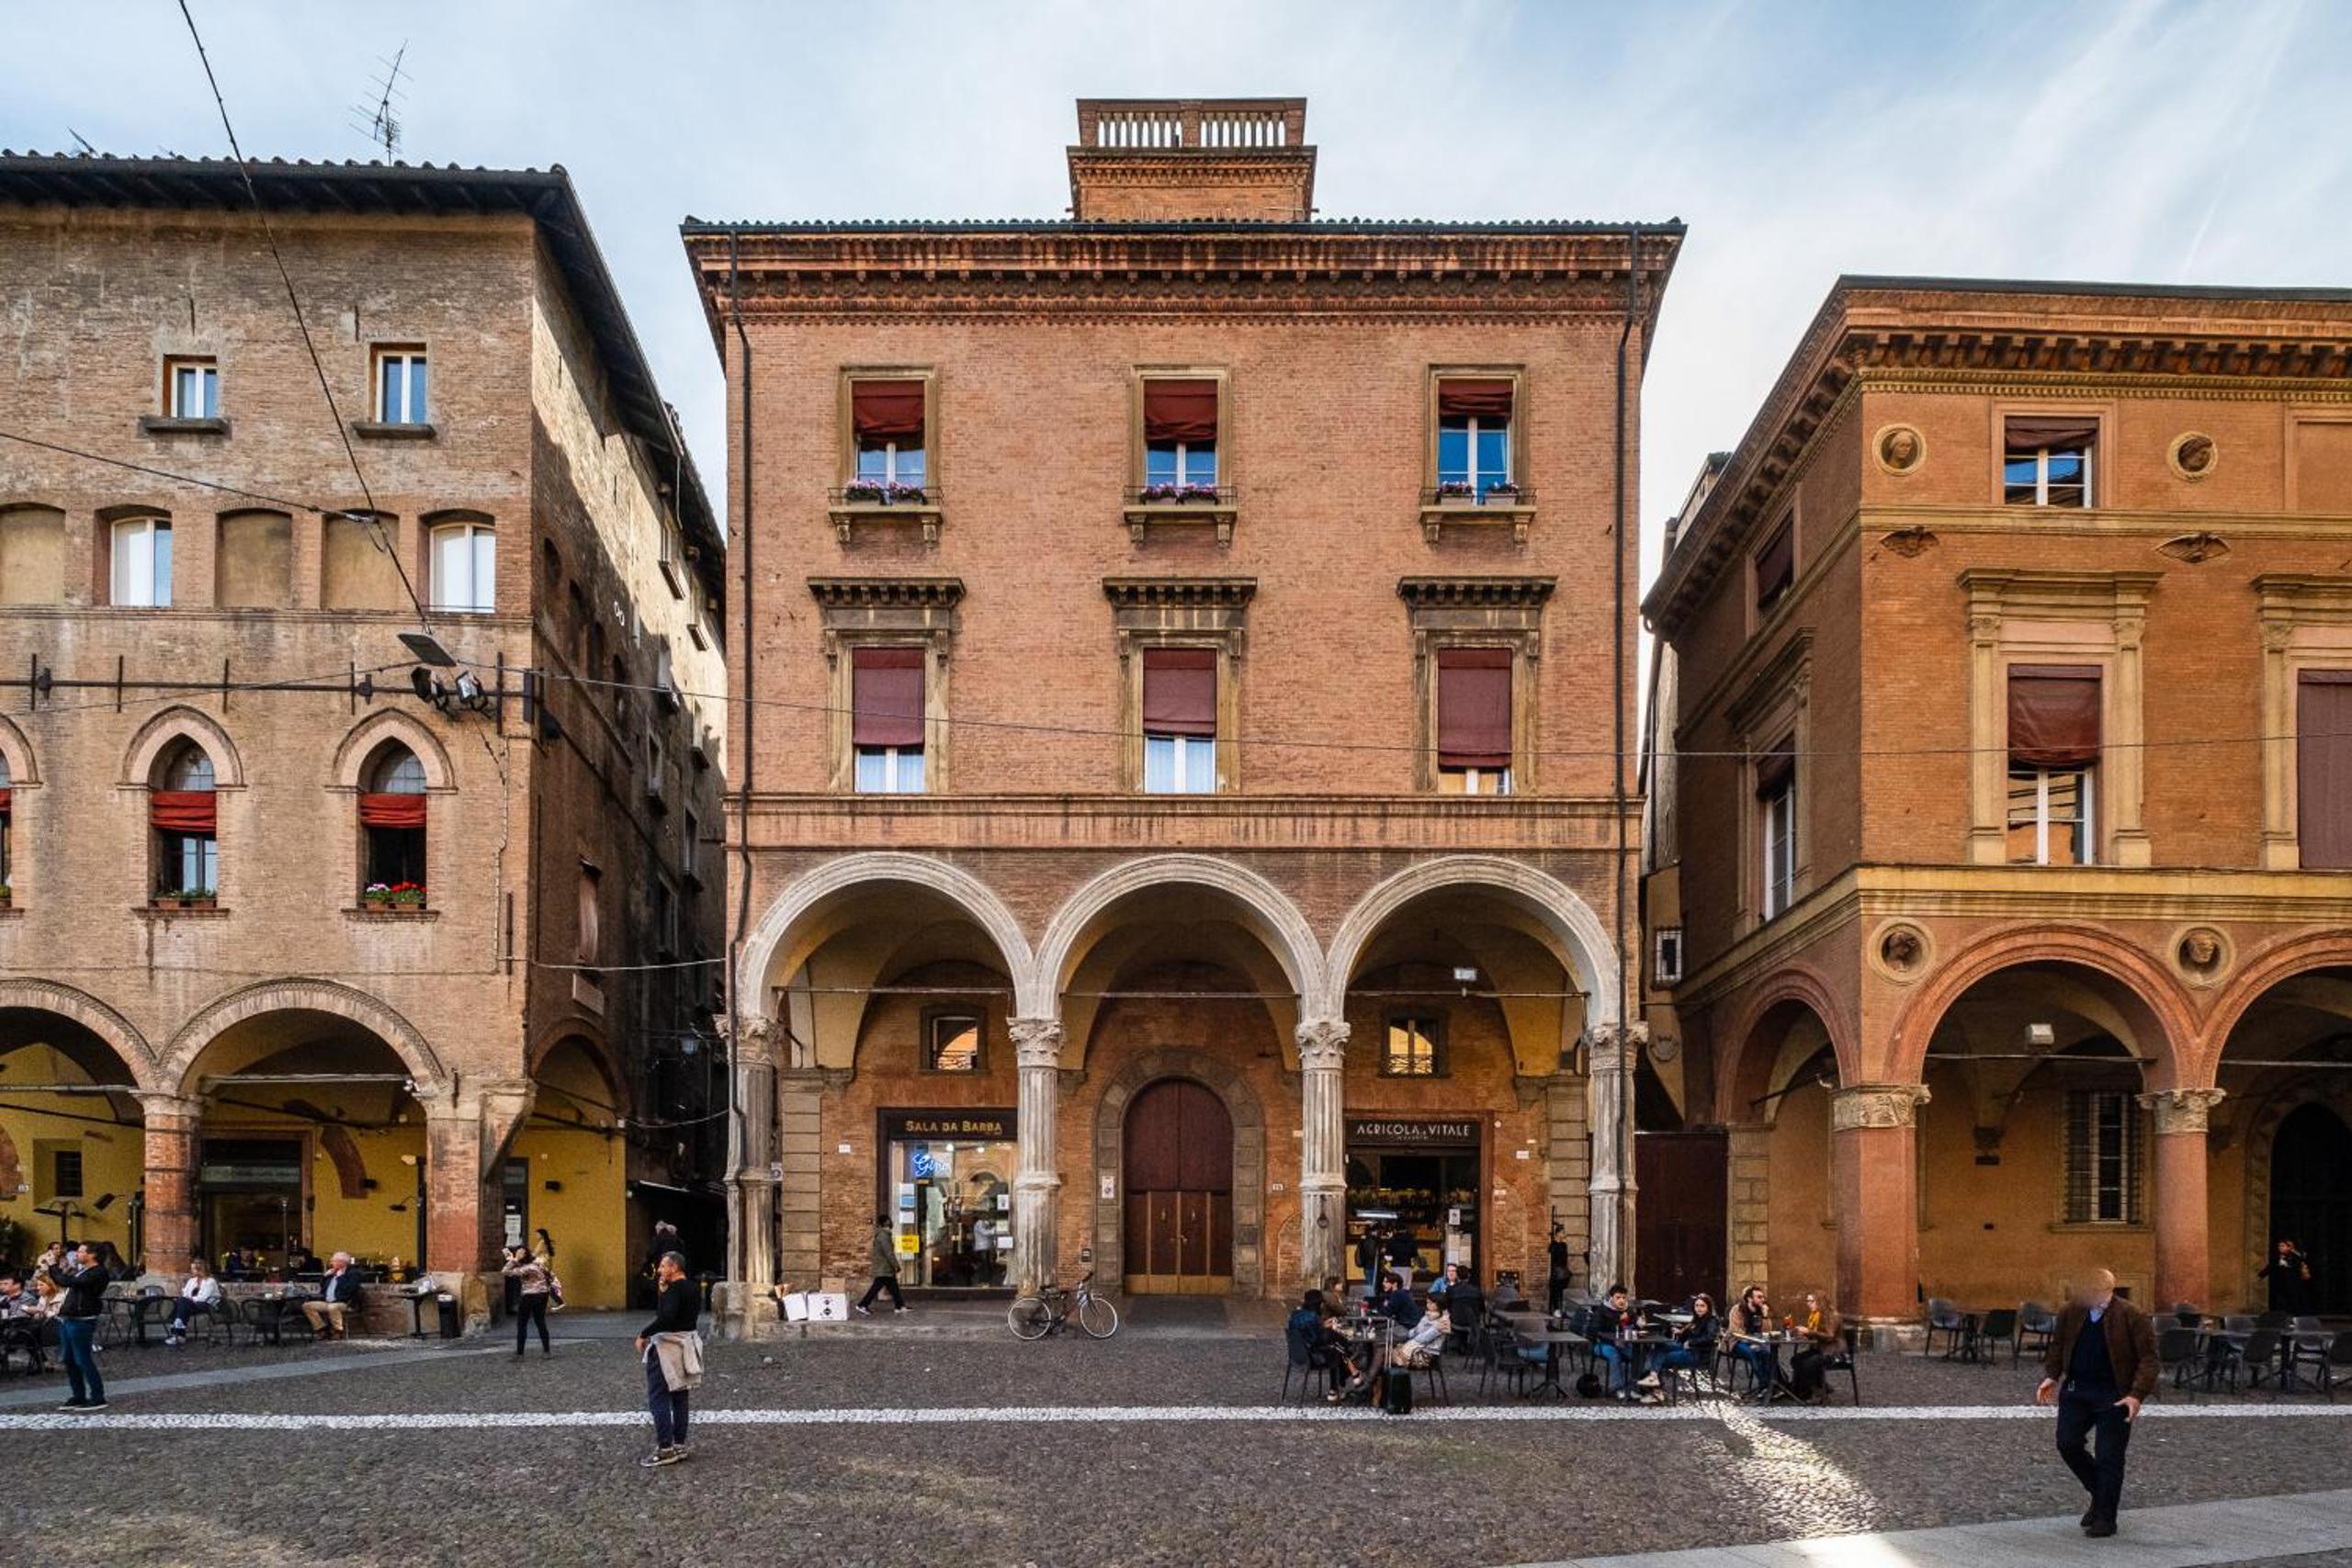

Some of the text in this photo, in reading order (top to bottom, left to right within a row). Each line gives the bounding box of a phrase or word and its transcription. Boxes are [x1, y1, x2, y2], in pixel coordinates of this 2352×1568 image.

[906, 1121, 938, 1132] SALA
[962, 1121, 1002, 1132] BARBA
[1356, 1123, 1419, 1135] AGRICOLA
[1428, 1123, 1470, 1136] VITALE
